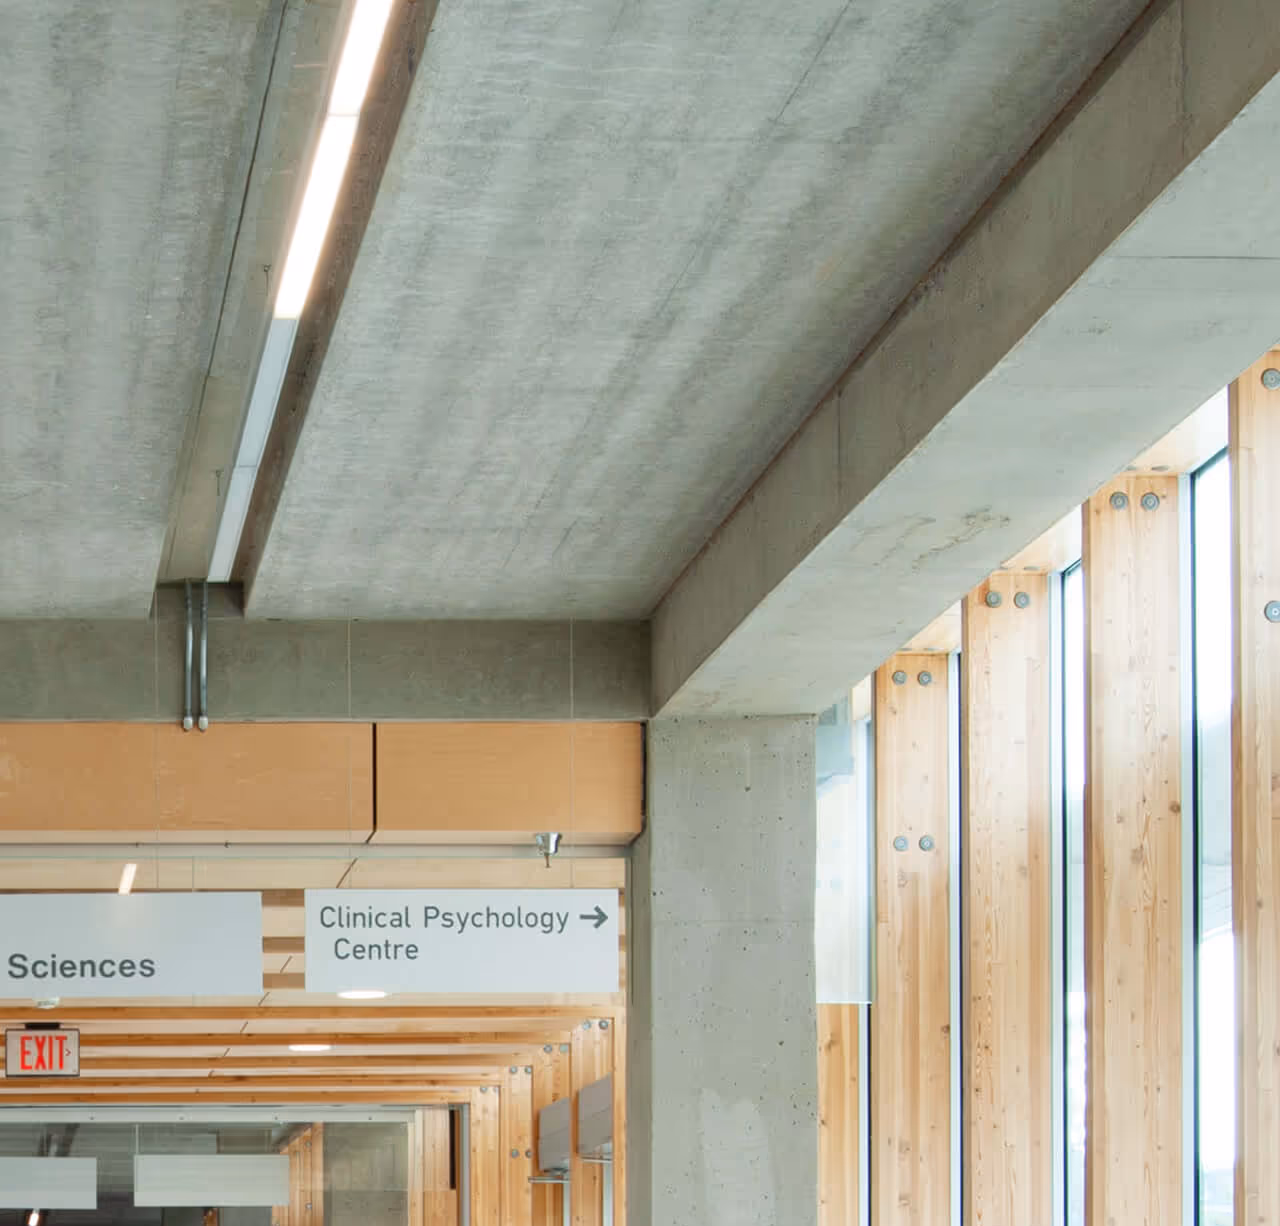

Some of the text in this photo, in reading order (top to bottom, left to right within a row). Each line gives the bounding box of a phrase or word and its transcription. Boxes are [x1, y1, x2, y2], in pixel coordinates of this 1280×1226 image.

[319, 905, 569, 934] Clinical Psychology
[333, 937, 419, 961] Centre
[7, 953, 156, 980] Sciences
[20, 1035, 67, 1070] EXIT
